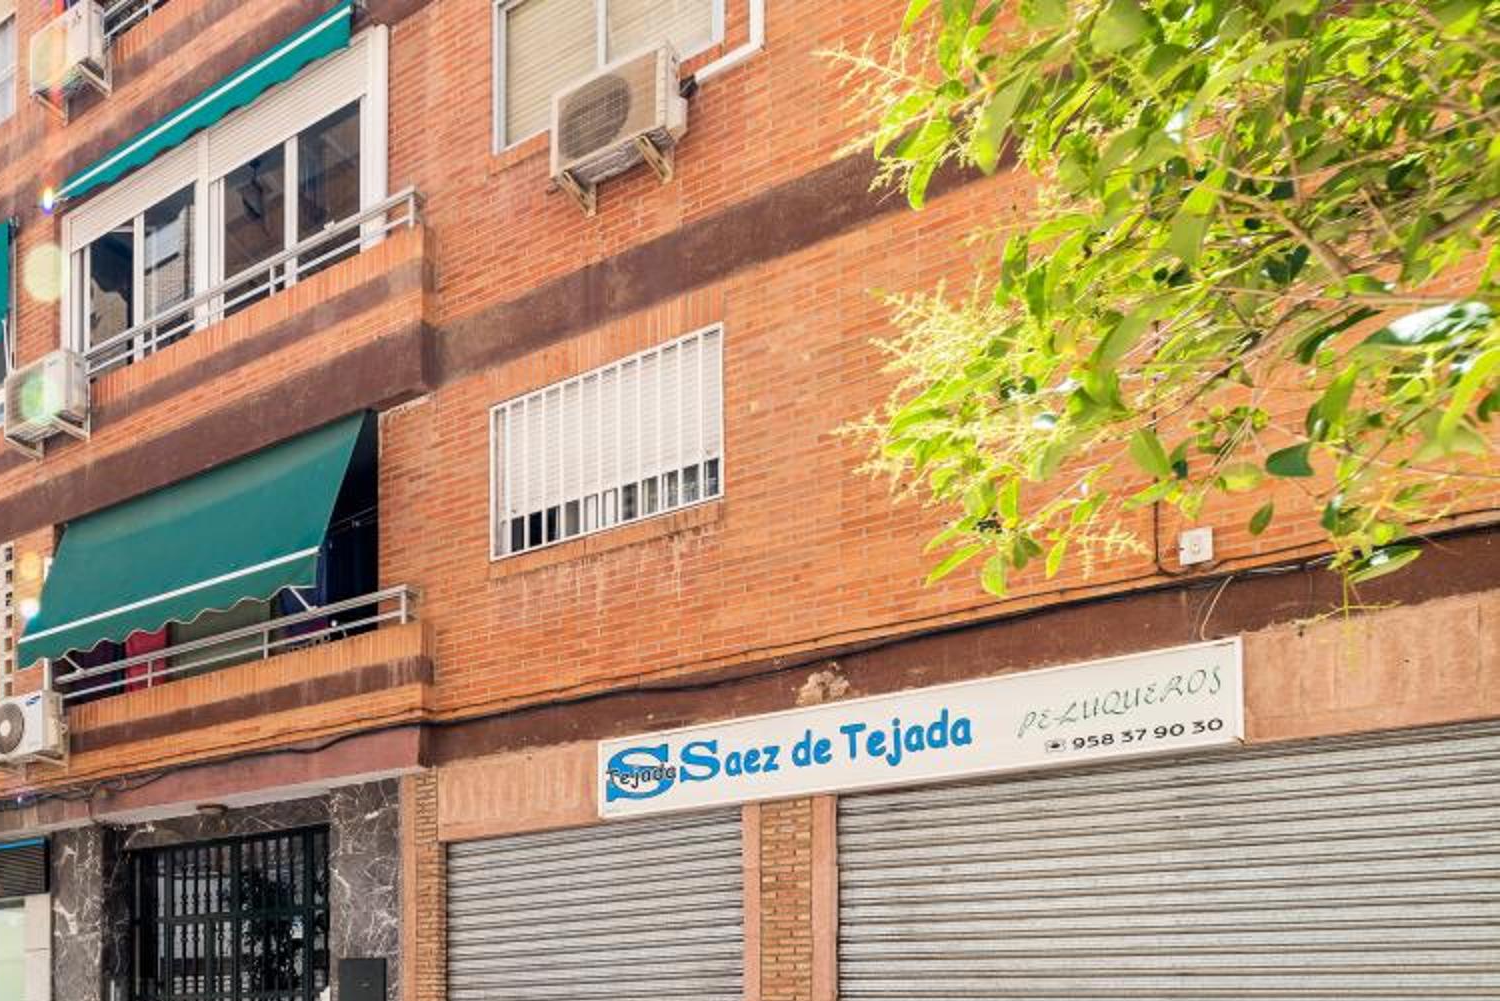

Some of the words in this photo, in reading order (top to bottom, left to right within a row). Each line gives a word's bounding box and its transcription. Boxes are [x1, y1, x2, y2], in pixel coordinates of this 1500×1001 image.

[1016, 665, 1222, 738] PELUQUEROS
[679, 740, 781, 783] Saez
[791, 729, 833, 768] de
[839, 708, 973, 767] Tejada
[1072, 733, 1115, 750] 958
[1120, 728, 1147, 743] 37
[1153, 723, 1185, 739] 90
[1191, 717, 1224, 735] 30
[605, 763, 677, 789] Tejada
